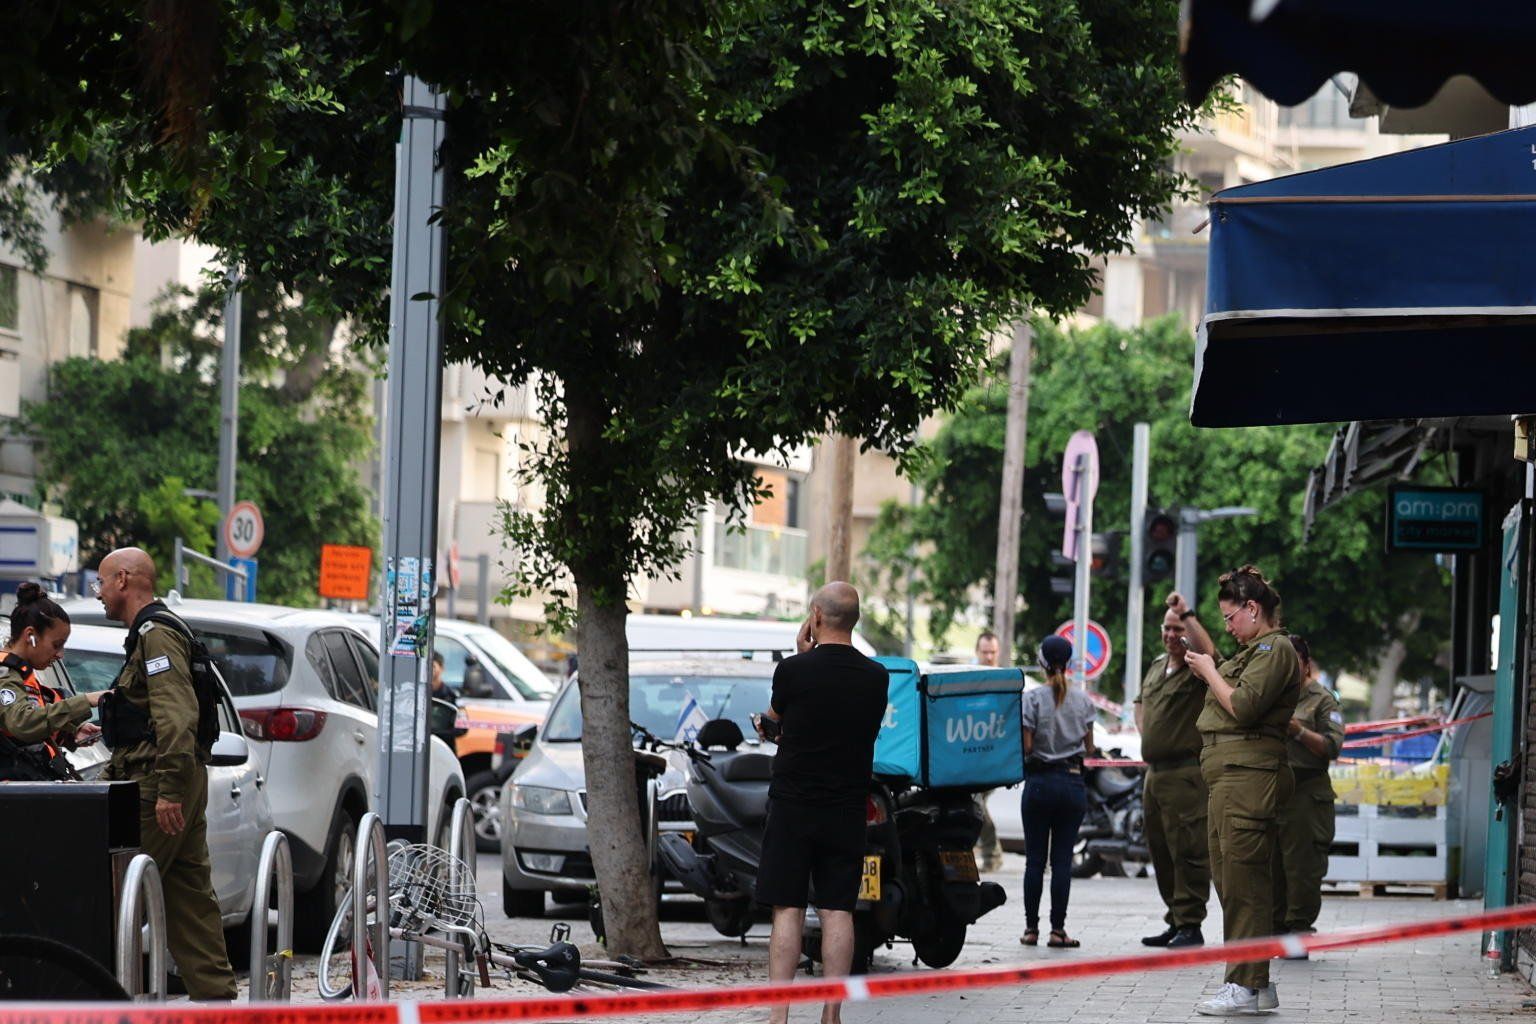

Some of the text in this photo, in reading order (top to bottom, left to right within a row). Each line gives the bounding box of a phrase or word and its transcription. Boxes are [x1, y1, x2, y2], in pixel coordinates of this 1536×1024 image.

[1396, 501, 1478, 519] am:pm
[233, 517, 254, 542] 30
[945, 712, 1006, 743] Wolt
